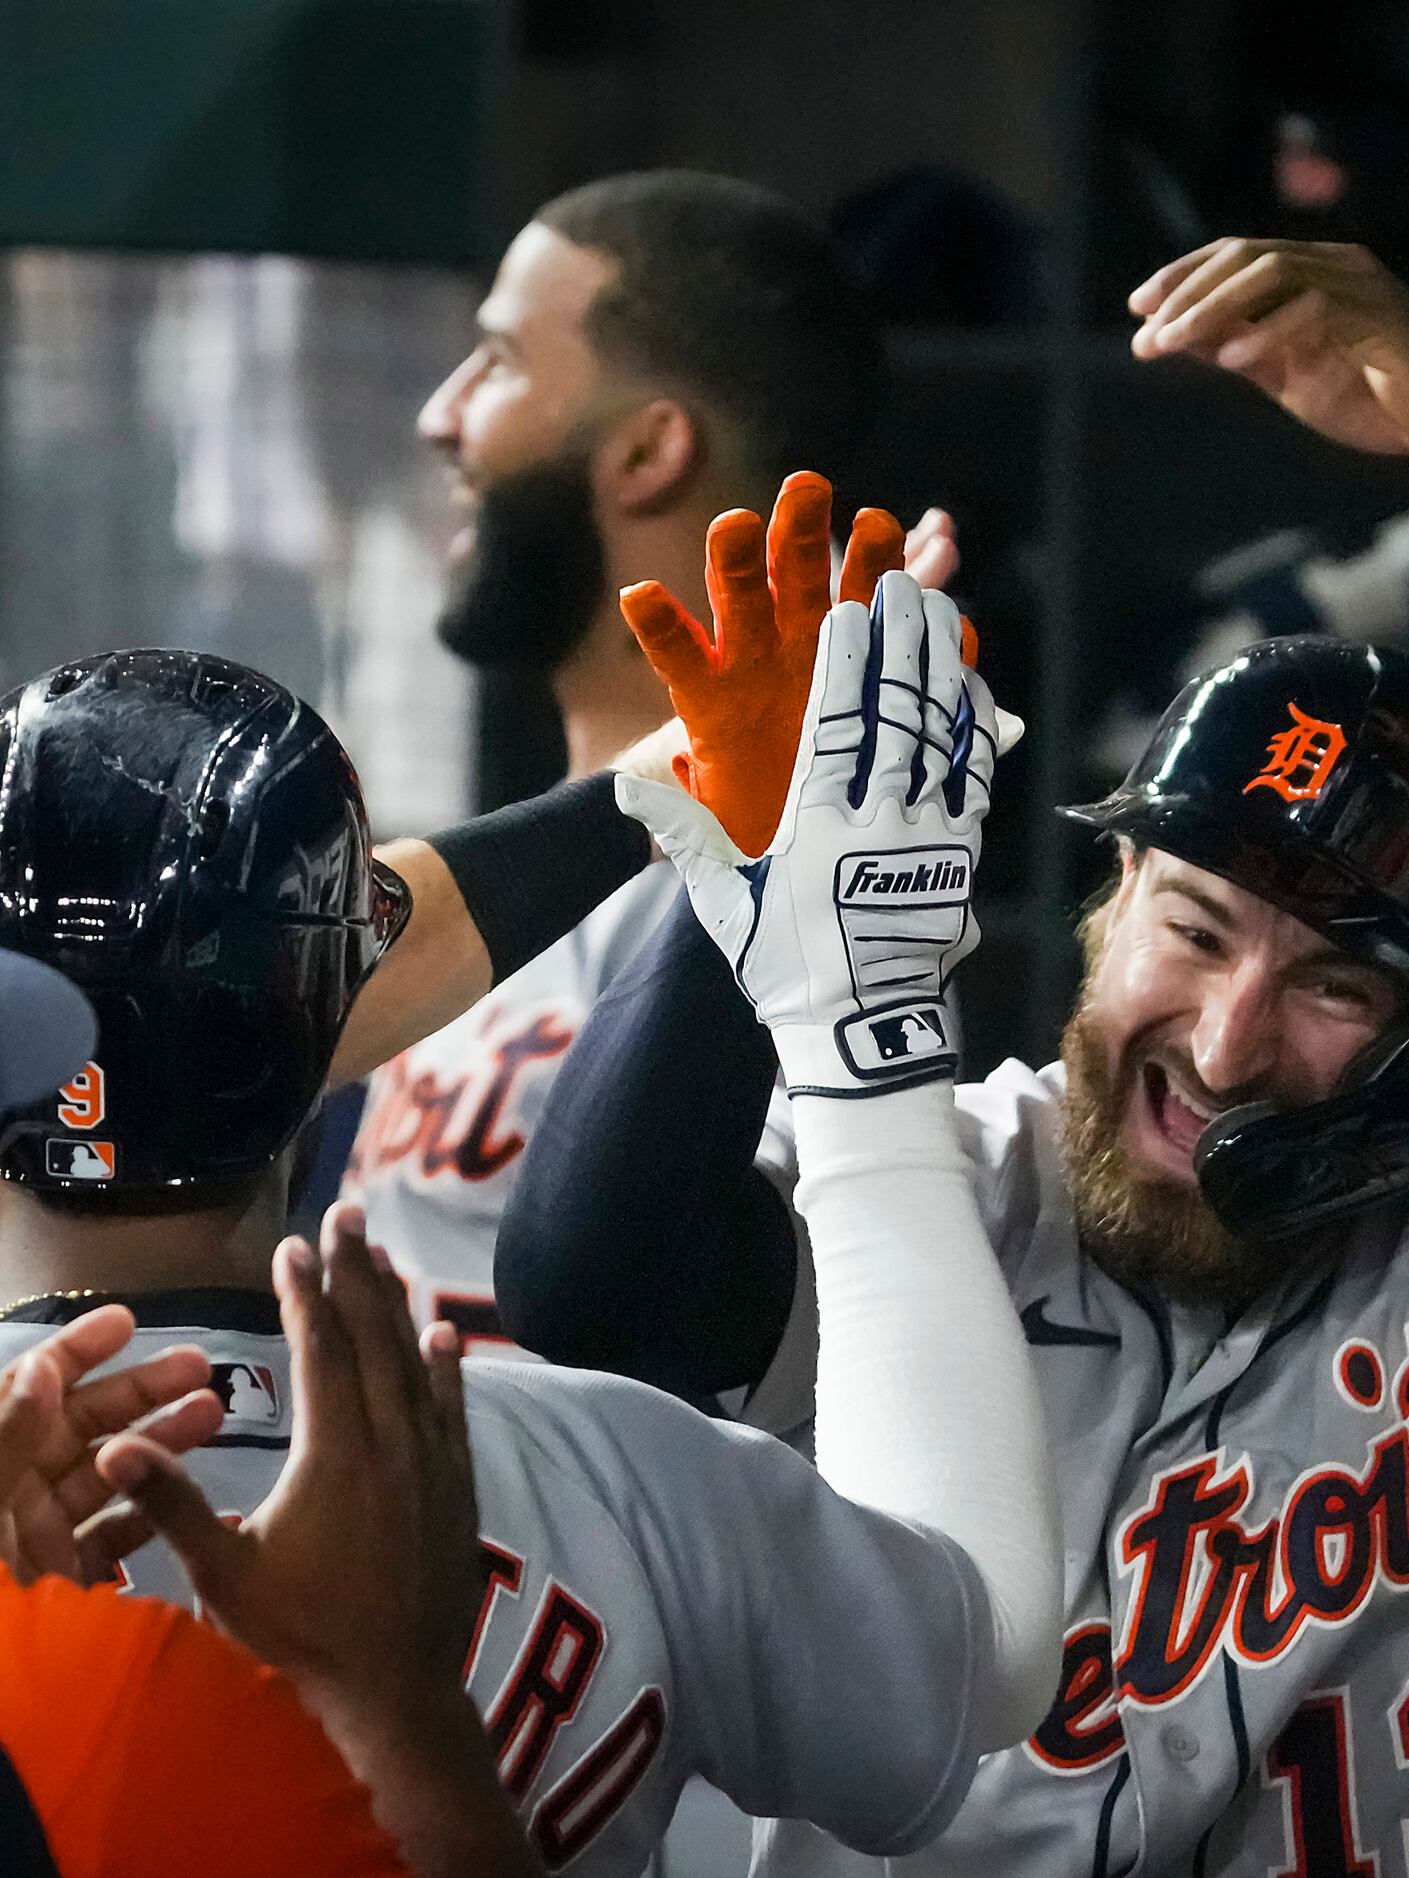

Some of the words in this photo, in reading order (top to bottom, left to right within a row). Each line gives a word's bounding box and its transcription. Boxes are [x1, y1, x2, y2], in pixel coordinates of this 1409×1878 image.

[1242, 701, 1347, 803] D
[843, 861, 966, 899] Franklin
[57, 1060, 105, 1129] 9
